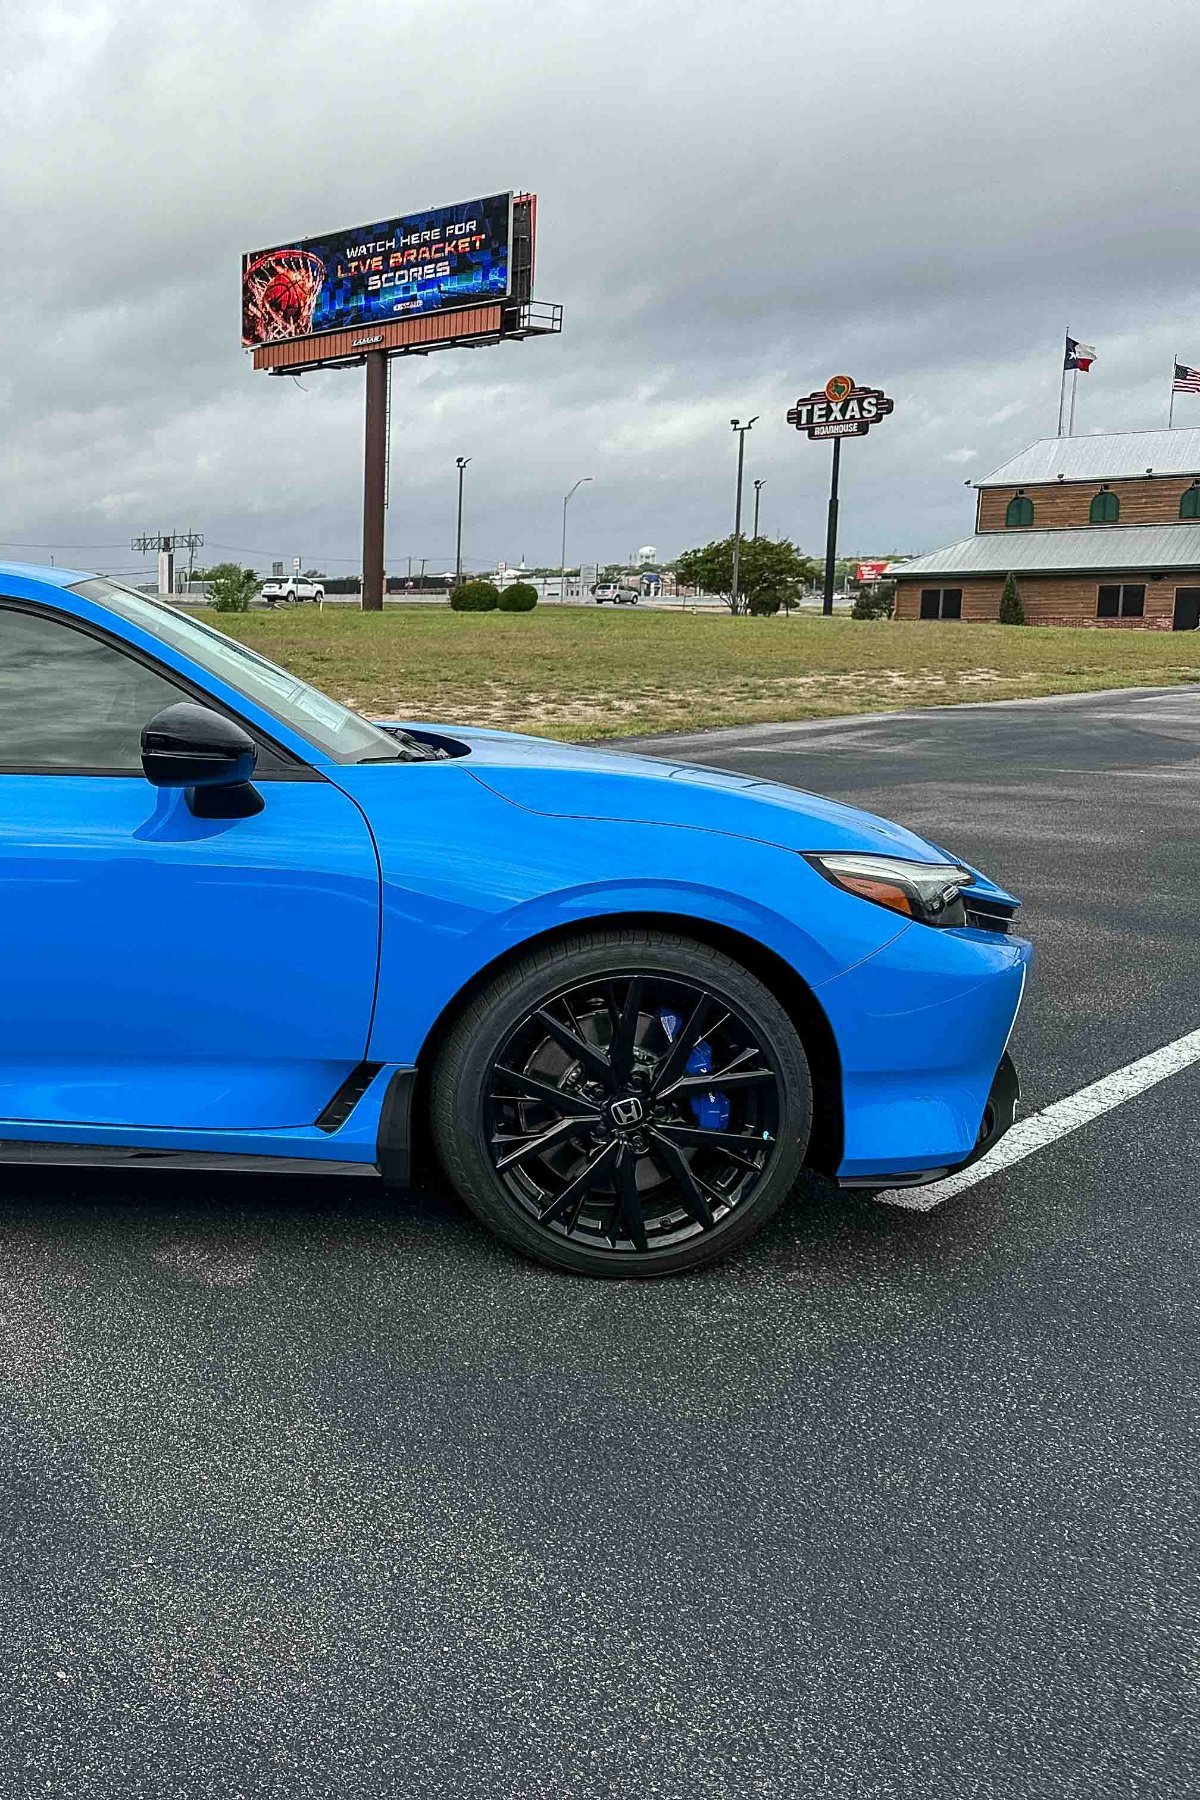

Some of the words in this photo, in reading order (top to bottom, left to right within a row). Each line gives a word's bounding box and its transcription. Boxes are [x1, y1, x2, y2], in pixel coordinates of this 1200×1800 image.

[346, 238, 395, 258] WATCH
[400, 228, 440, 247] HERE
[446, 220, 477, 237] FOR
[337, 256, 383, 278] LIVE
[389, 233, 486, 268] BRACKET
[367, 261, 451, 291] SCORES
[352, 335, 382, 346] LAMAR
[798, 397, 877, 424] TEXAS
[814, 422, 859, 436] ROADHOUSE
